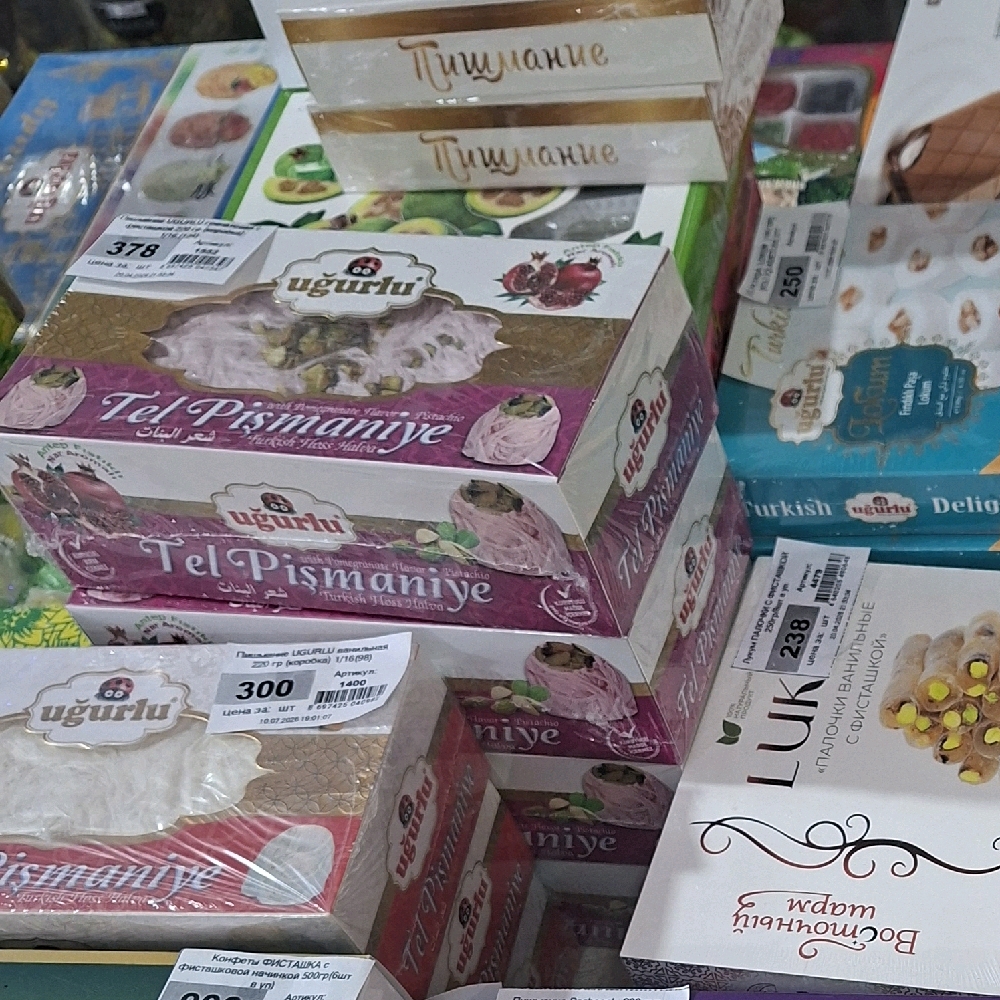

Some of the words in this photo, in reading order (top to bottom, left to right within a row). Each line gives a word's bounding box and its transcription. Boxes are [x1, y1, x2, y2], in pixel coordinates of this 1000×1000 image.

[398, 38, 609, 93] Пишмание
[420, 132, 618, 182] Пишмание
[107, 241, 160, 258] 378
[287, 272, 416, 299] uğurlu
[780, 266, 804, 298] 250
[795, 364, 826, 434] uğurlu
[101, 392, 183, 424] Tel
[181, 398, 453, 455] Pişmaniye
[228, 507, 346, 534] uğurlu
[139, 537, 220, 577] Tel
[227, 548, 493, 612] Pişmaniye
[780, 618, 811, 659] 238
[236, 680, 294, 700] 300
[334, 669, 378, 678] Артикул:
[340, 680, 366, 688] 1400
[816, 695, 846, 775] «ПАЛОЧКИ
[836, 601, 876, 692] ВАНИЛЬНЫЕ
[41, 699, 171, 728] uğurlu
[747, 678, 826, 790] LUK
[0, 851, 226, 903] işmaniye
[787, 897, 876, 920] шарм
[733, 908, 921, 957] Восточный
[178, 963, 250, 977] фисташковой
[252, 969, 300, 980] начинкой
[301, 971, 353, 983] 500гр(6шт
[211, 953, 260, 966] Конфеты
[262, 958, 322, 969] ФИСТАШКА
